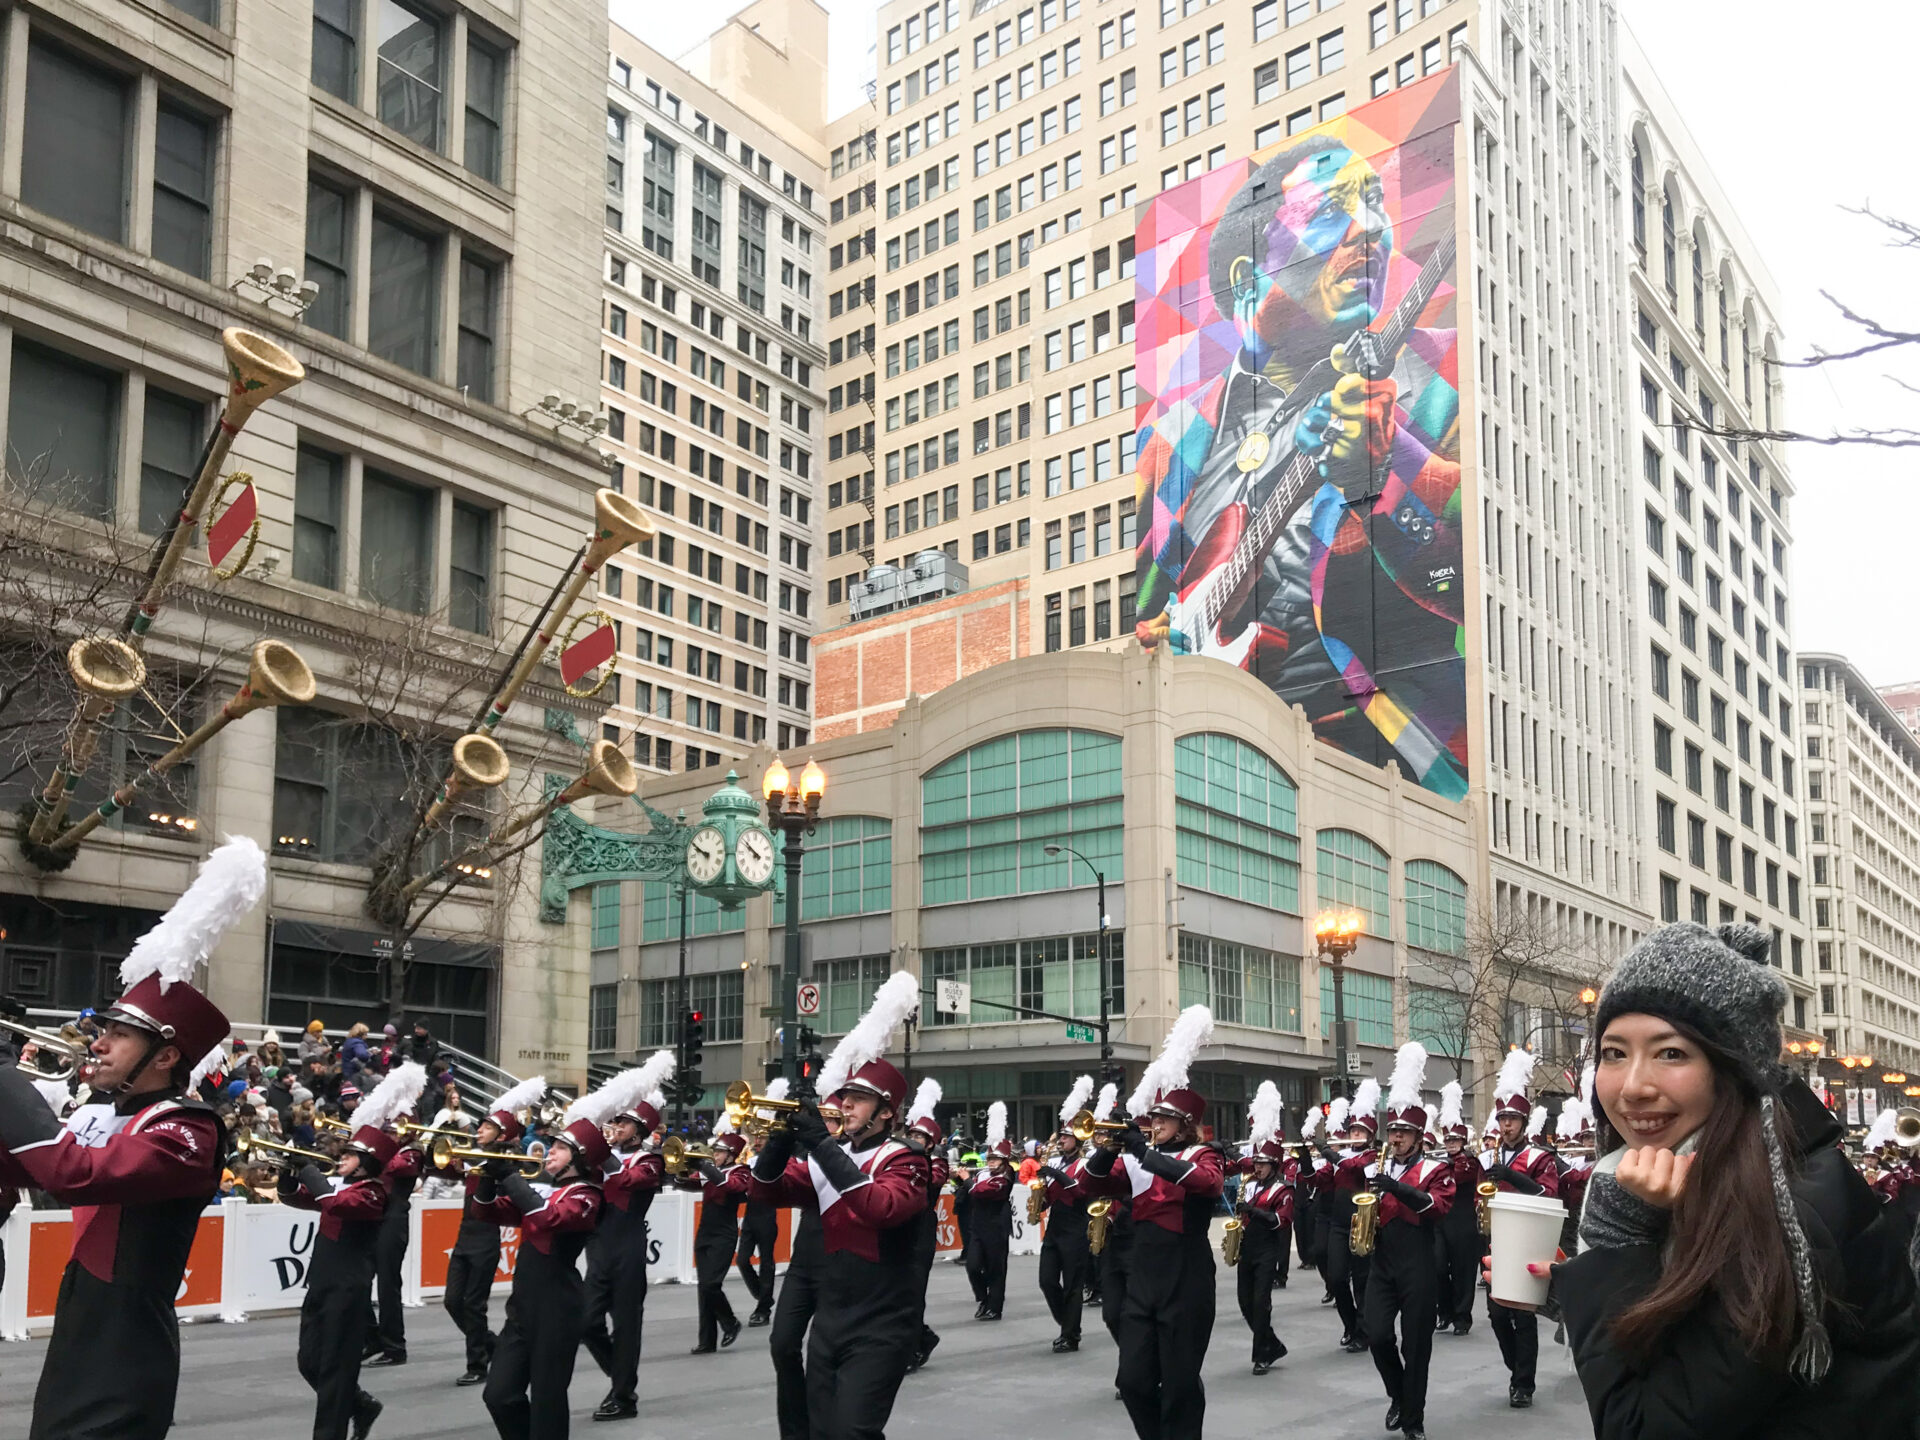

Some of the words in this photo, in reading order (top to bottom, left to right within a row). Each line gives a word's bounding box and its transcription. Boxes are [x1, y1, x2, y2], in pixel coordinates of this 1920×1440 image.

[1429, 566, 1456, 579] KOBRA
[944, 987, 963, 996] BUSES
[518, 1049, 541, 1060] STATE
[542, 1051, 571, 1062] STREET
